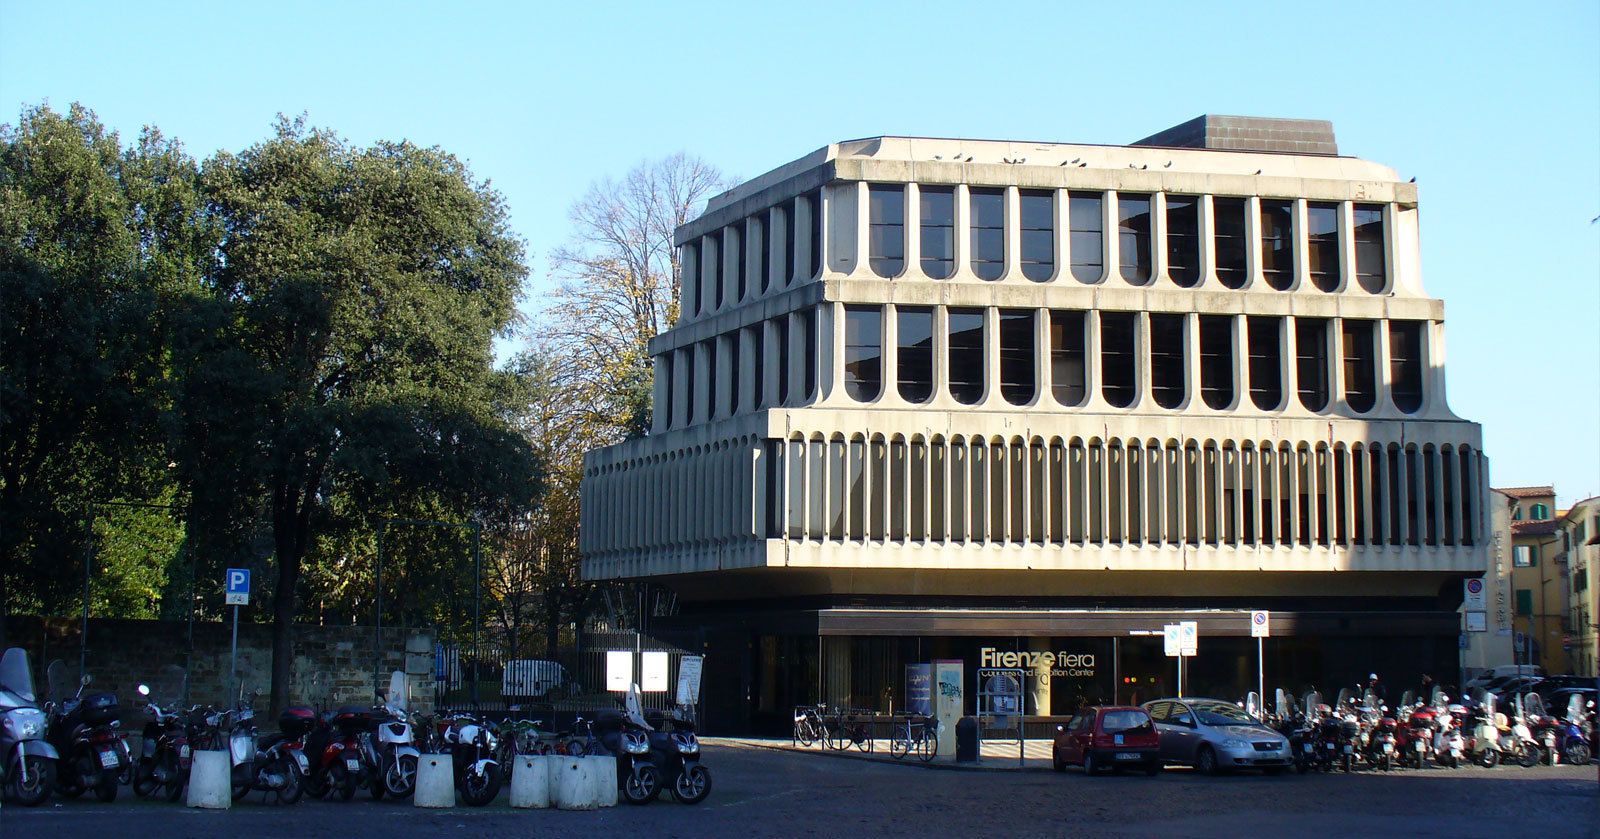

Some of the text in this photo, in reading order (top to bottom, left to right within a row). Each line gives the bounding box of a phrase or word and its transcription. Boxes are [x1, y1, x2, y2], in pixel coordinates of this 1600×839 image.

[231, 572, 246, 590] P
[981, 647, 1095, 668] Firenze fiera
[1034, 668, 1068, 677] Eition
[1069, 668, 1095, 677] Center
